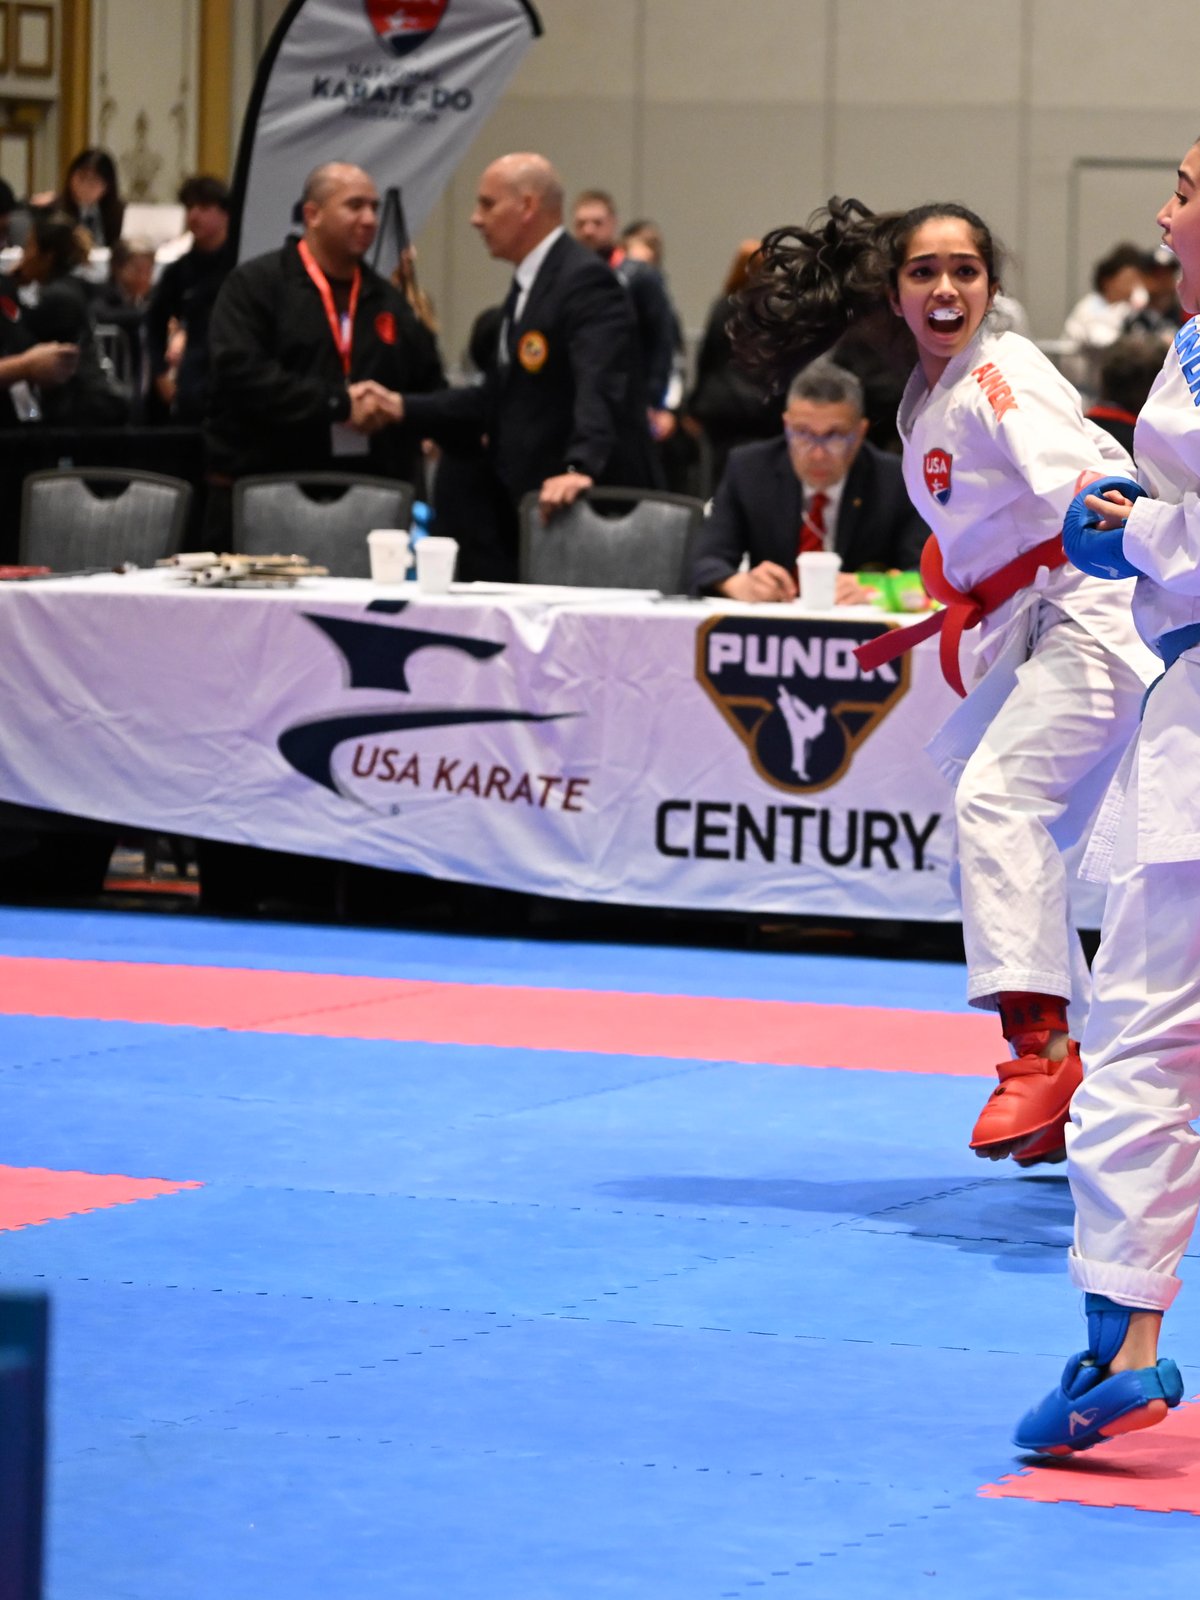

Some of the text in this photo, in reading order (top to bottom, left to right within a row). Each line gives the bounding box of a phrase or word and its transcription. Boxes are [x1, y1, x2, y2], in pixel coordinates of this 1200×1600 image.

[926, 456, 948, 475] USA
[352, 744, 592, 812] USA KARATE
